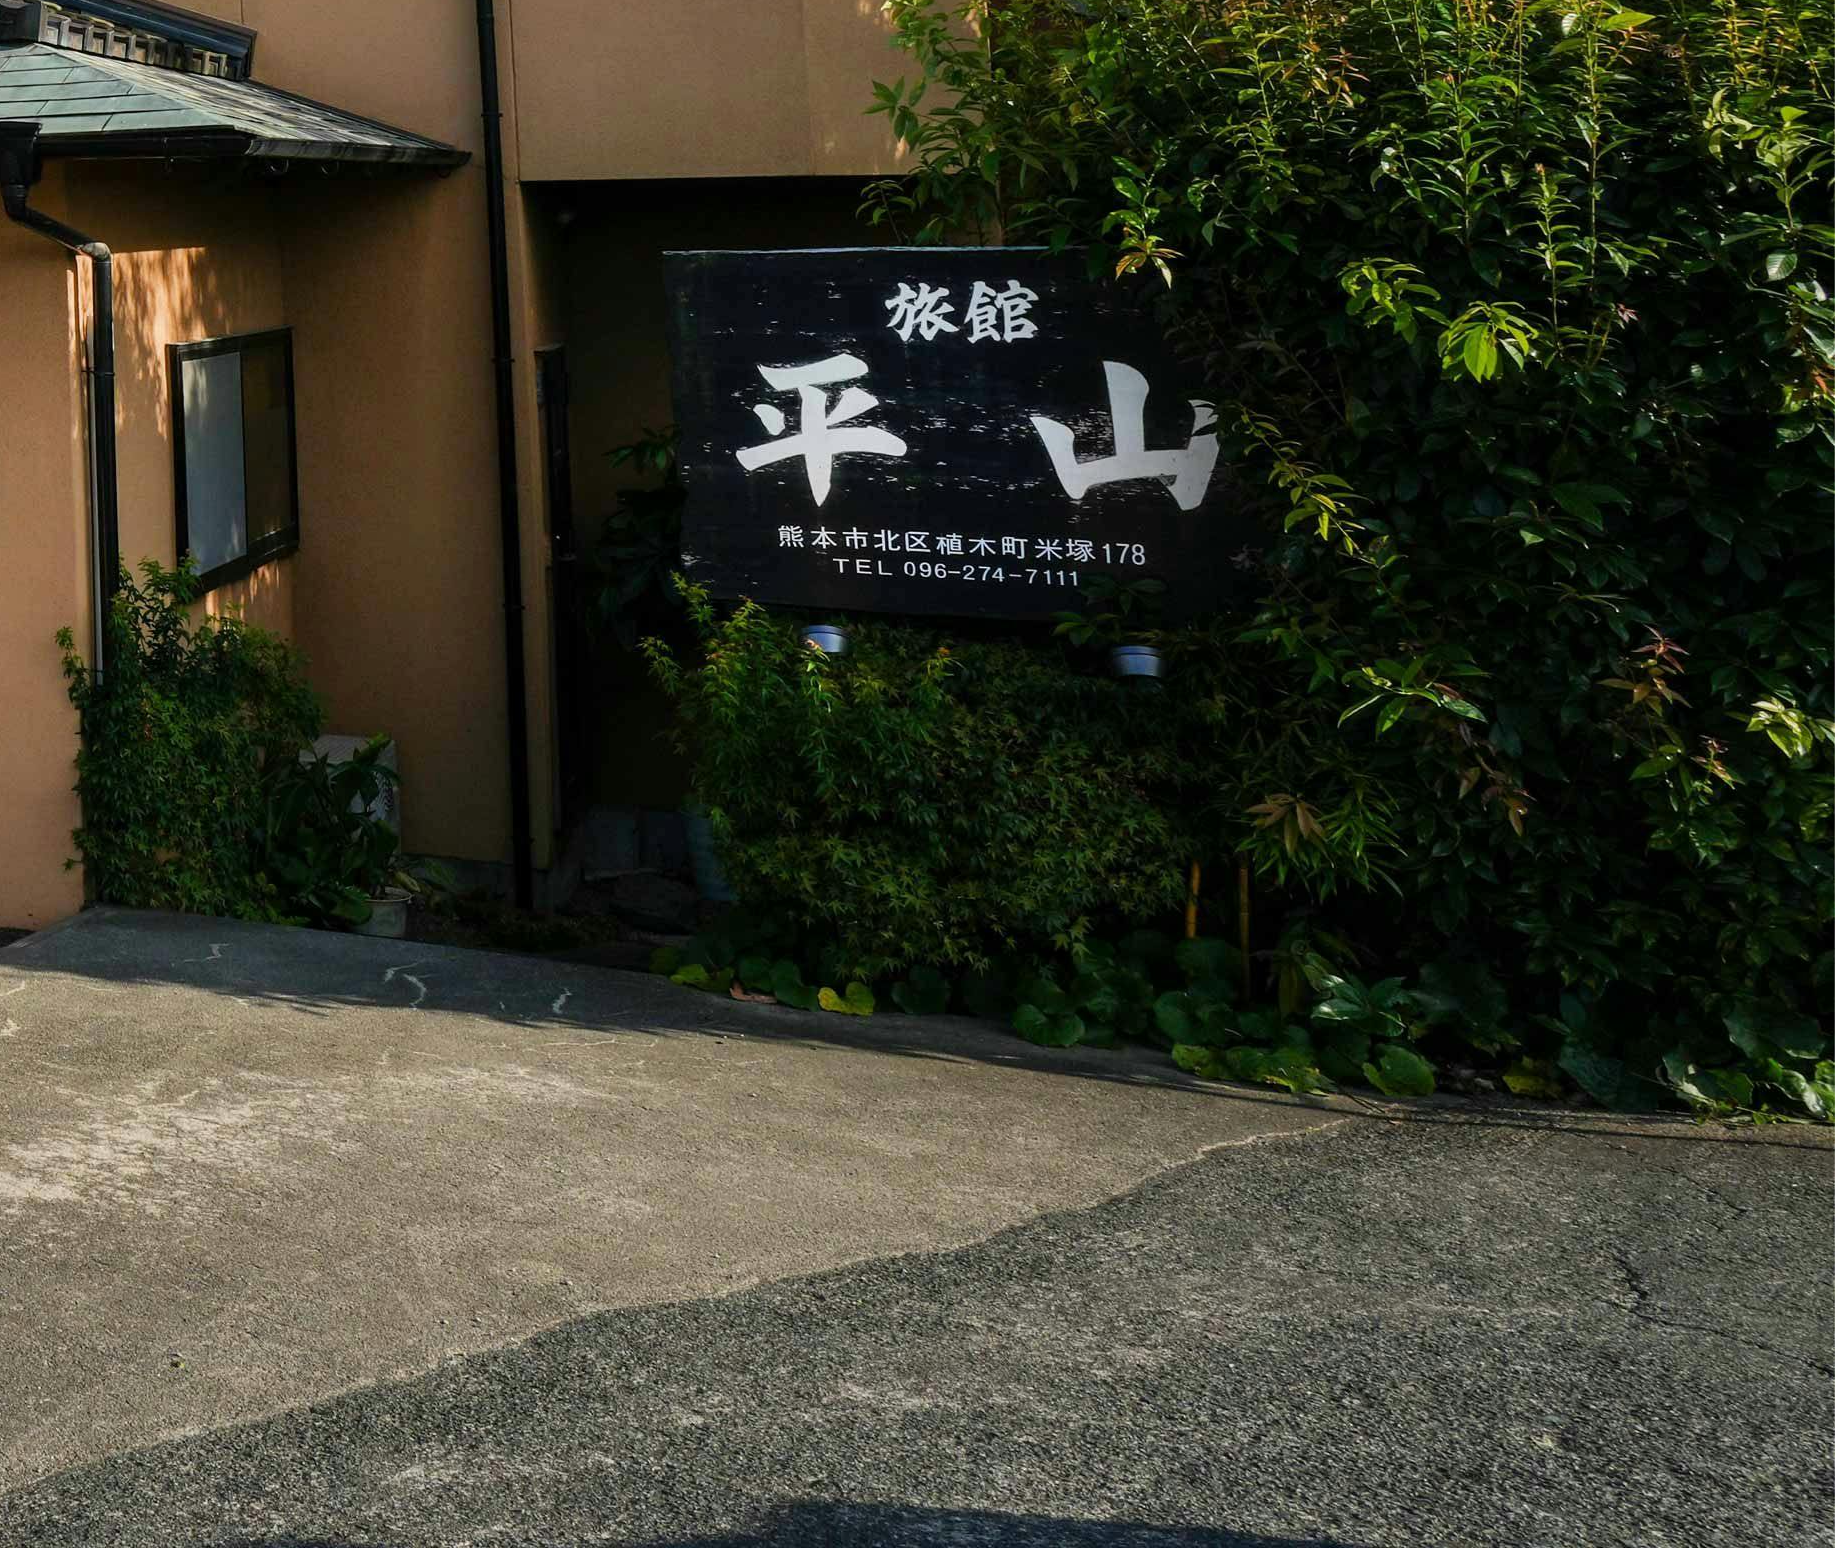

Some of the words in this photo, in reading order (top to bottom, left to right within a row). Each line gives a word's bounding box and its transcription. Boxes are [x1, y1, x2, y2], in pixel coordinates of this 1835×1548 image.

[885, 279, 1040, 344] 旅館
[832, 558, 893, 576] TEL
[904, 562, 1079, 587] 096-274-7111
